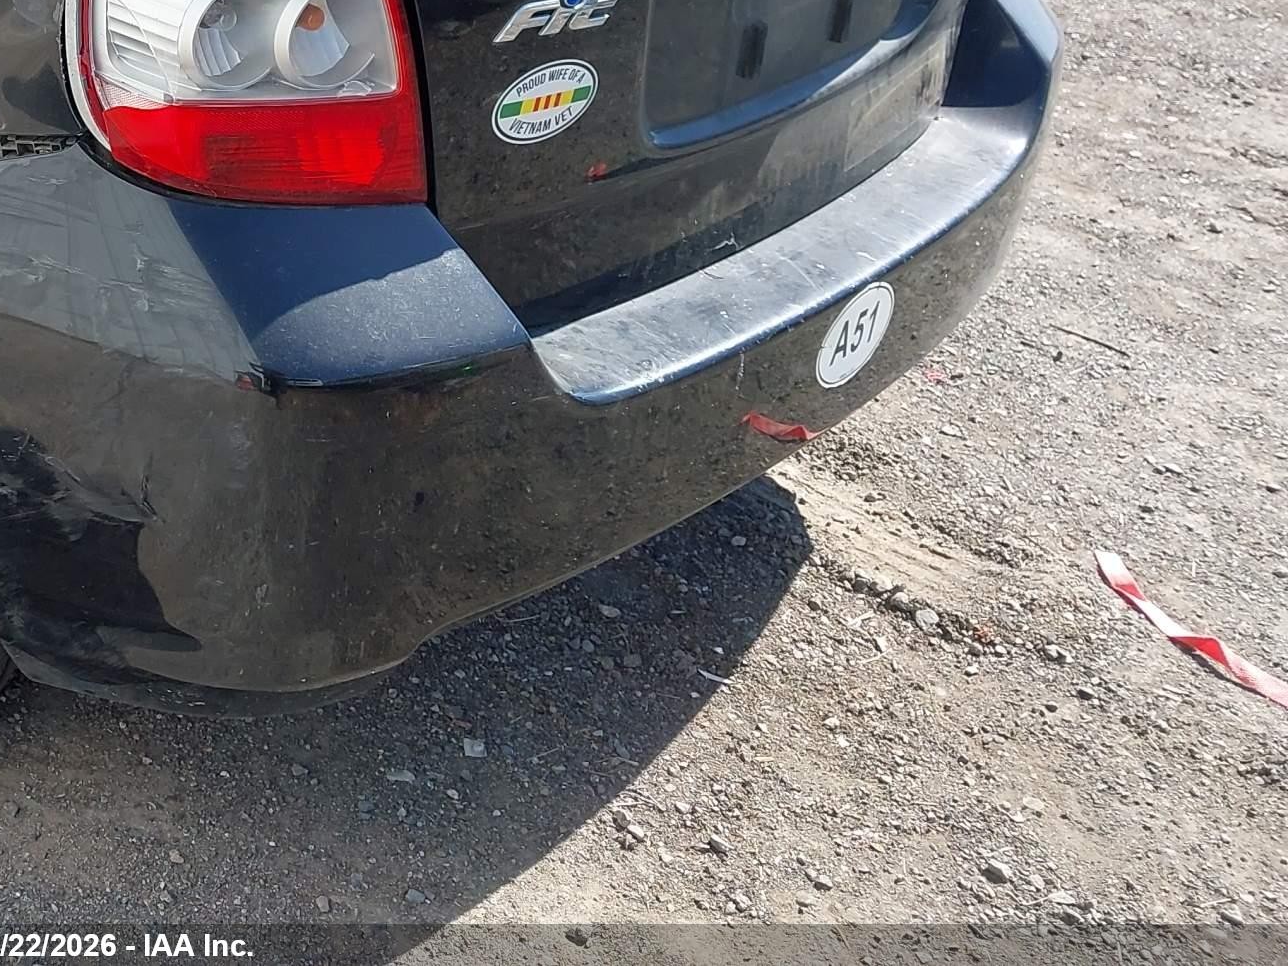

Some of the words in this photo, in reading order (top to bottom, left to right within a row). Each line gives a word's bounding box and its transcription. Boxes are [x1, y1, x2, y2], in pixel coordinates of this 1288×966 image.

[516, 73, 546, 97] PROUD
[548, 69, 568, 83] WIFE
[567, 69, 578, 81] OF
[509, 118, 552, 135] VIETNAM
[554, 107, 574, 127] VET
[829, 300, 880, 367] A51
